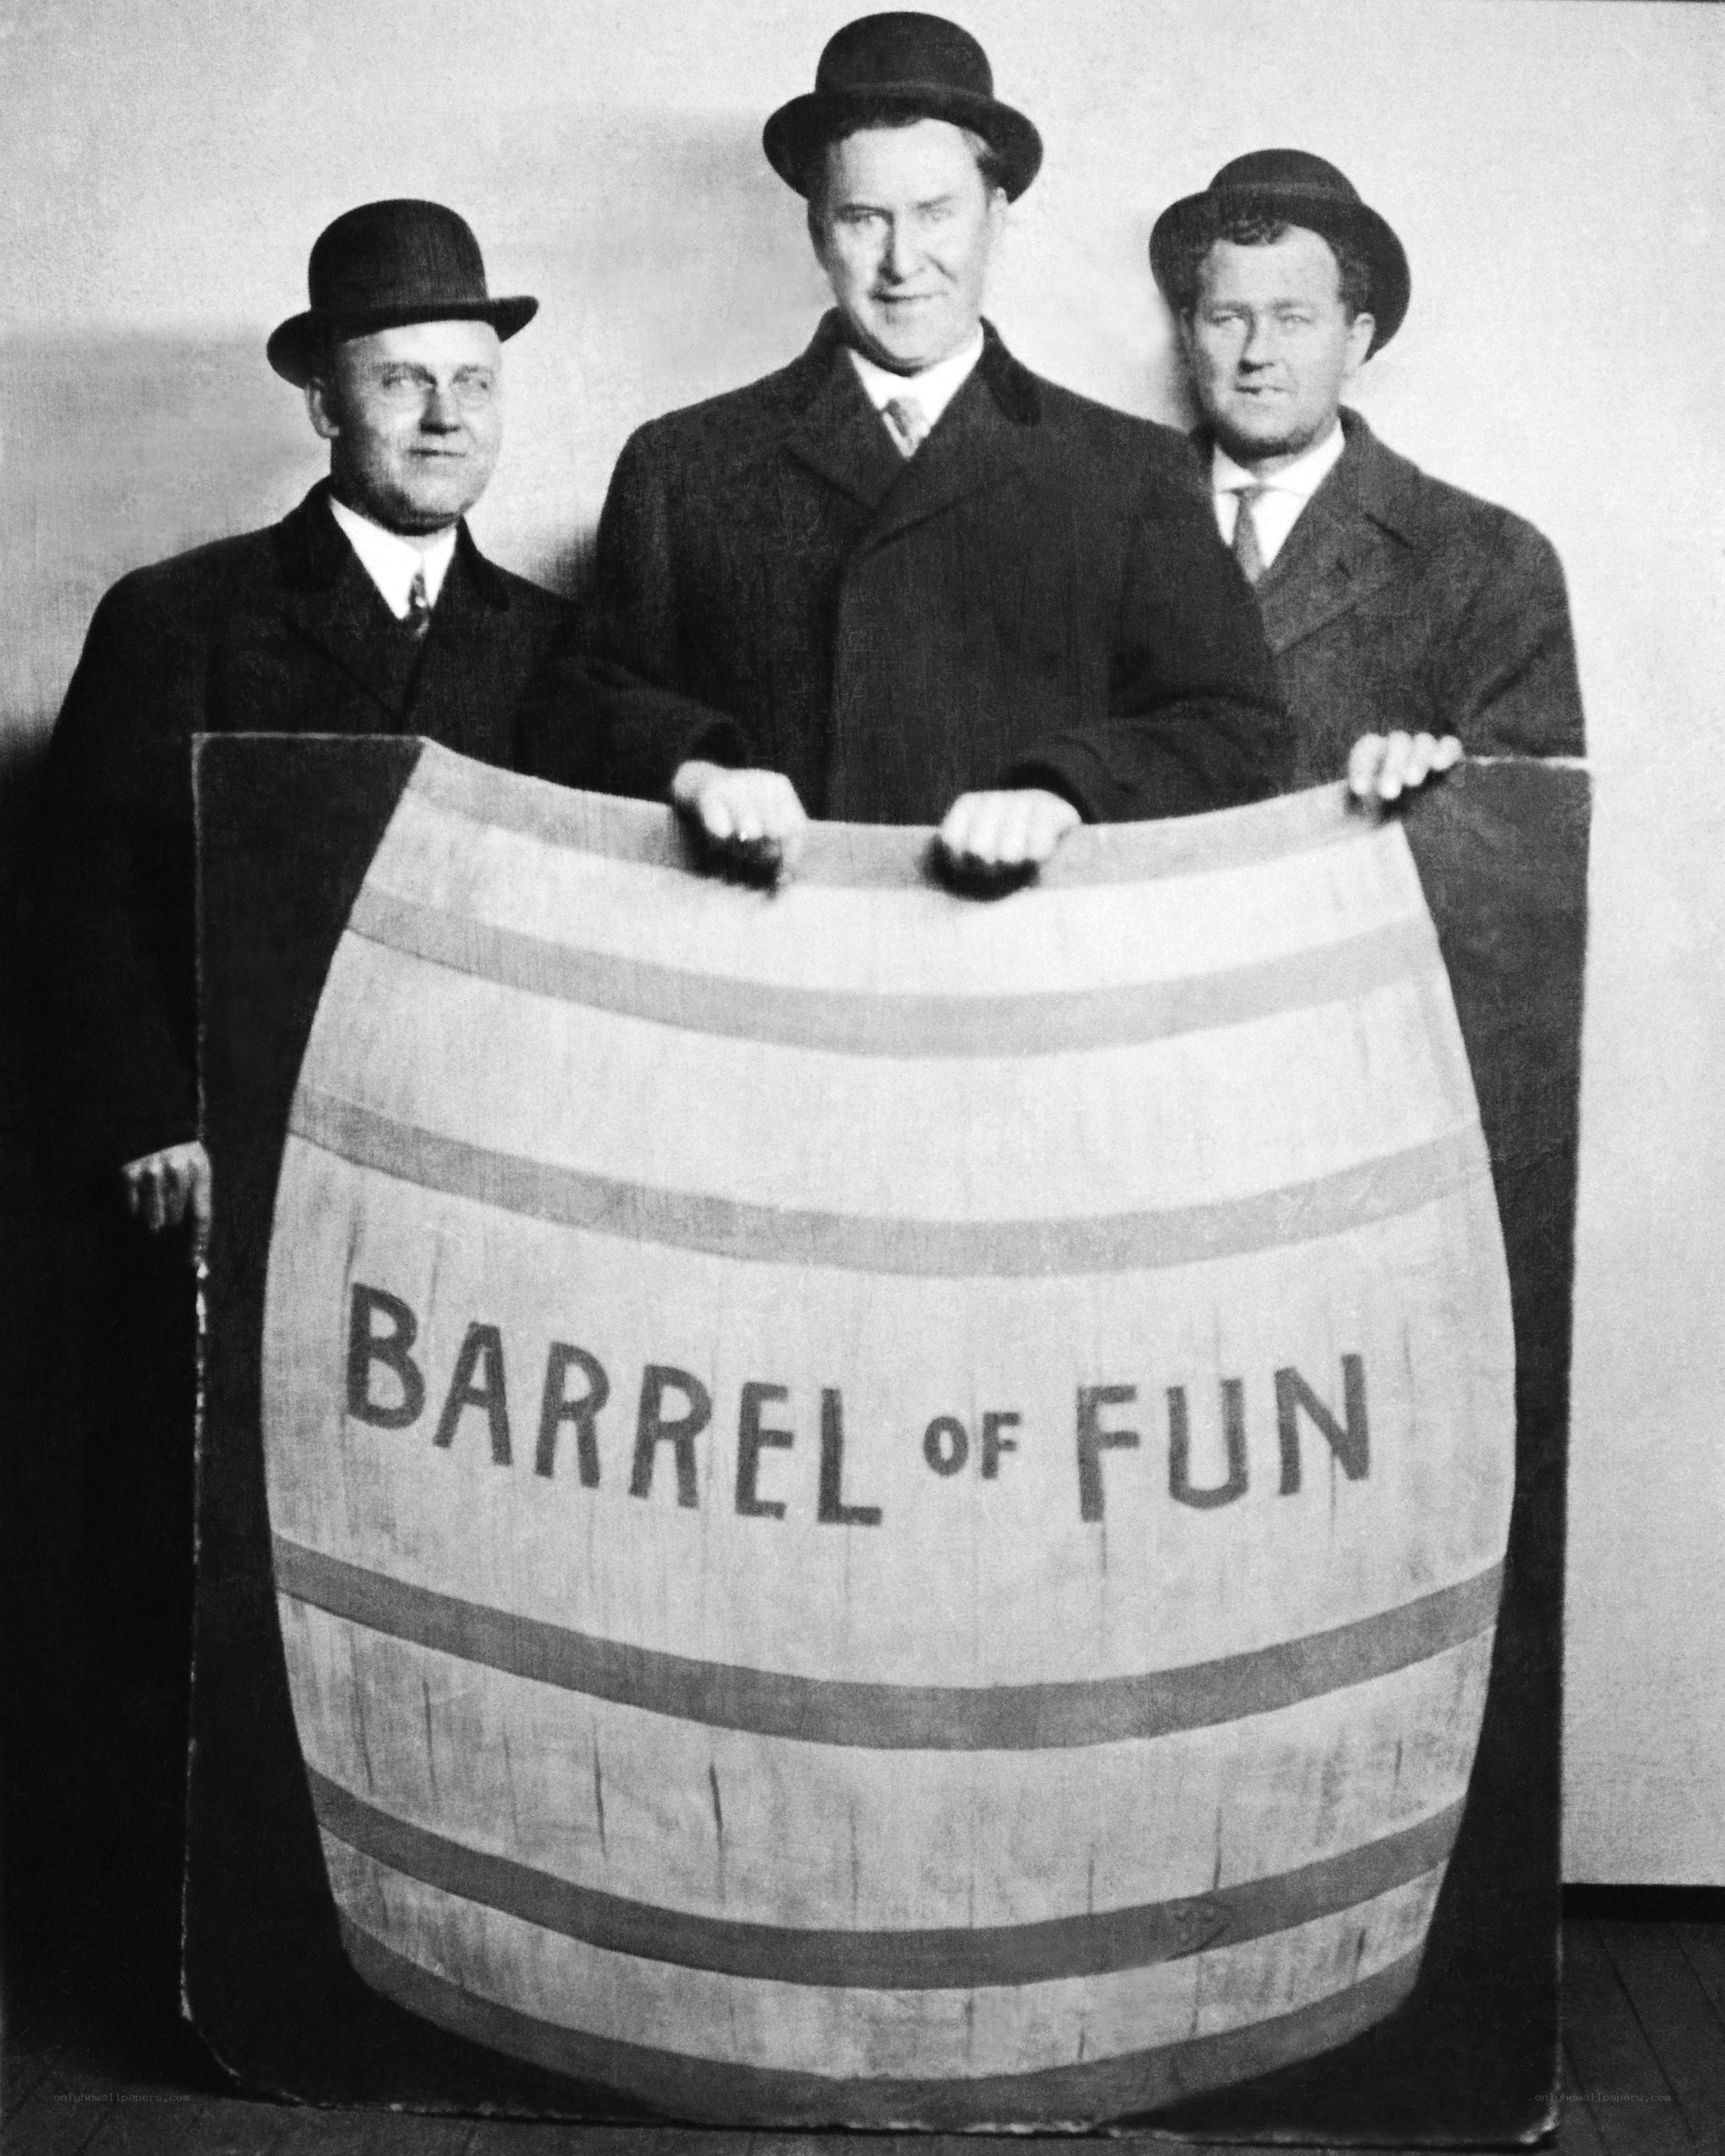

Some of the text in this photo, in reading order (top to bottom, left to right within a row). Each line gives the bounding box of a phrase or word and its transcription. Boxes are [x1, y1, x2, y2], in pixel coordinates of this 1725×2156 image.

[346, 1281, 1370, 1526] BARREL OF FUN
